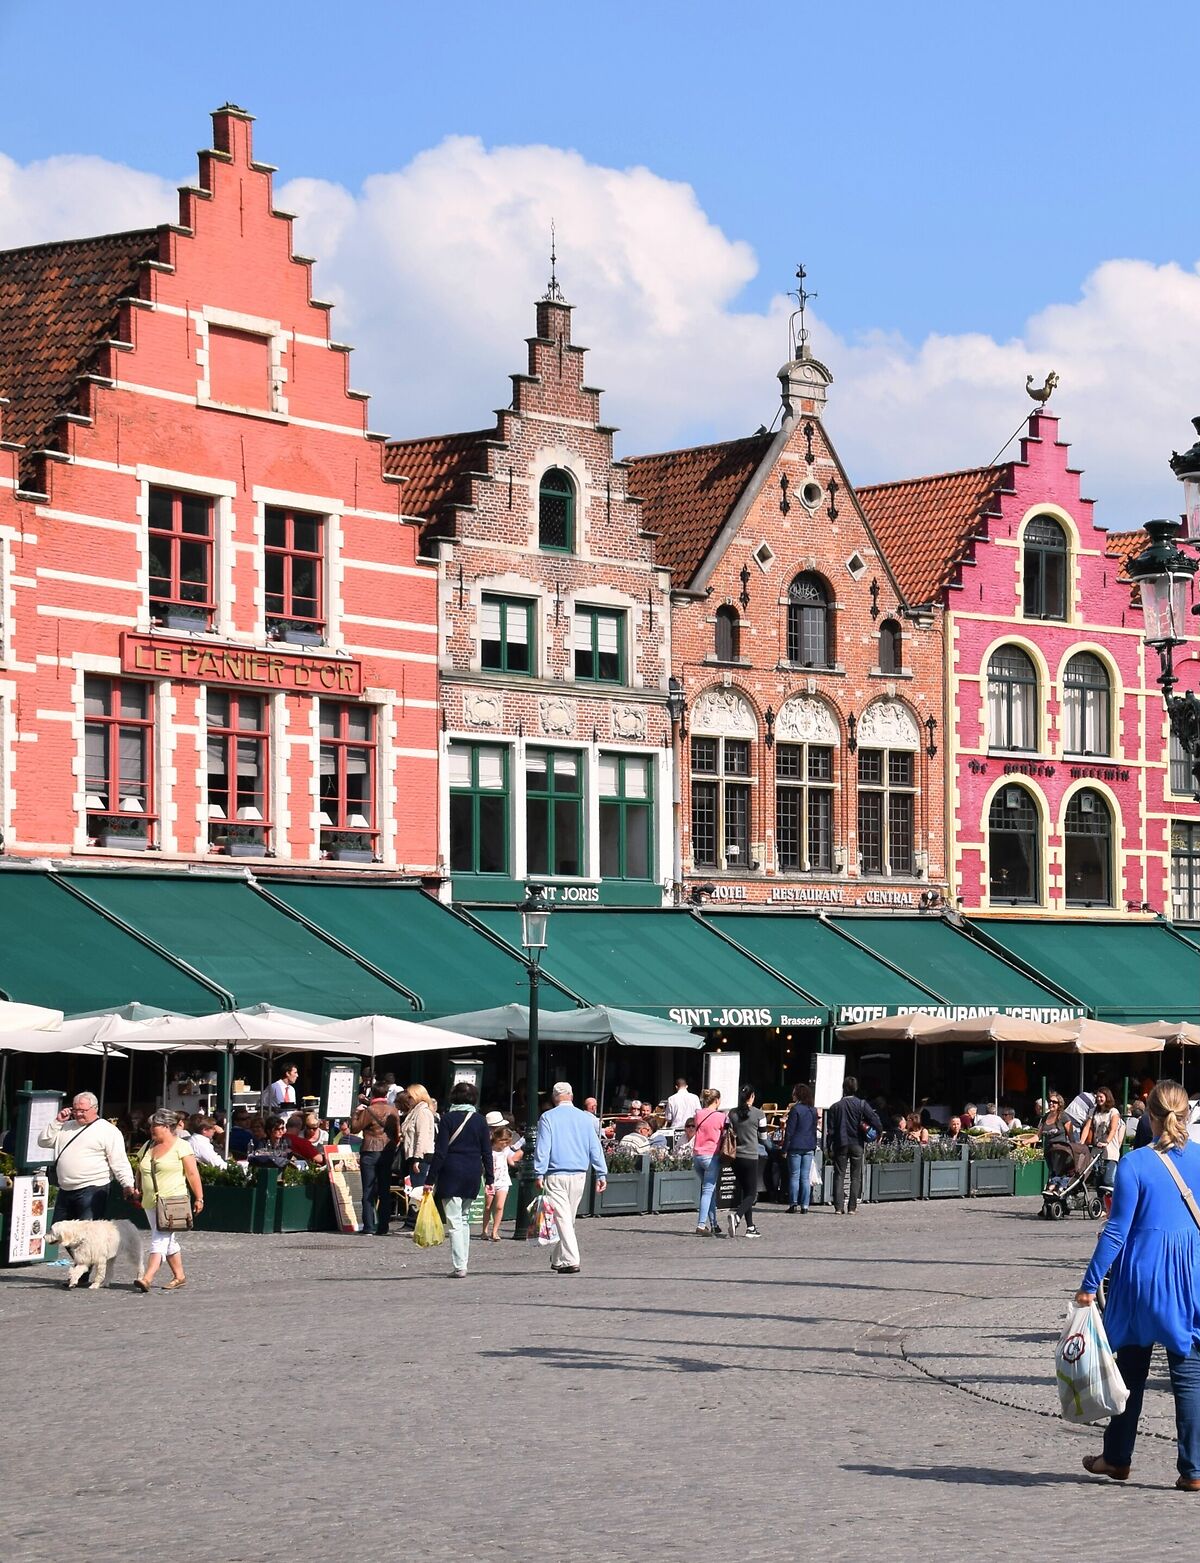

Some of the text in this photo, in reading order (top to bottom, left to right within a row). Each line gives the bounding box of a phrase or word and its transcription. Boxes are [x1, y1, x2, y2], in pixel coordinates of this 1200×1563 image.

[134, 645, 354, 691] LE PANIER D'OR
[525, 886, 600, 901] SNT JORIS
[711, 886, 914, 905] HOTEL RESTAURANT CENTRAL
[669, 1008, 822, 1026] SINT-JORIS Brasserie
